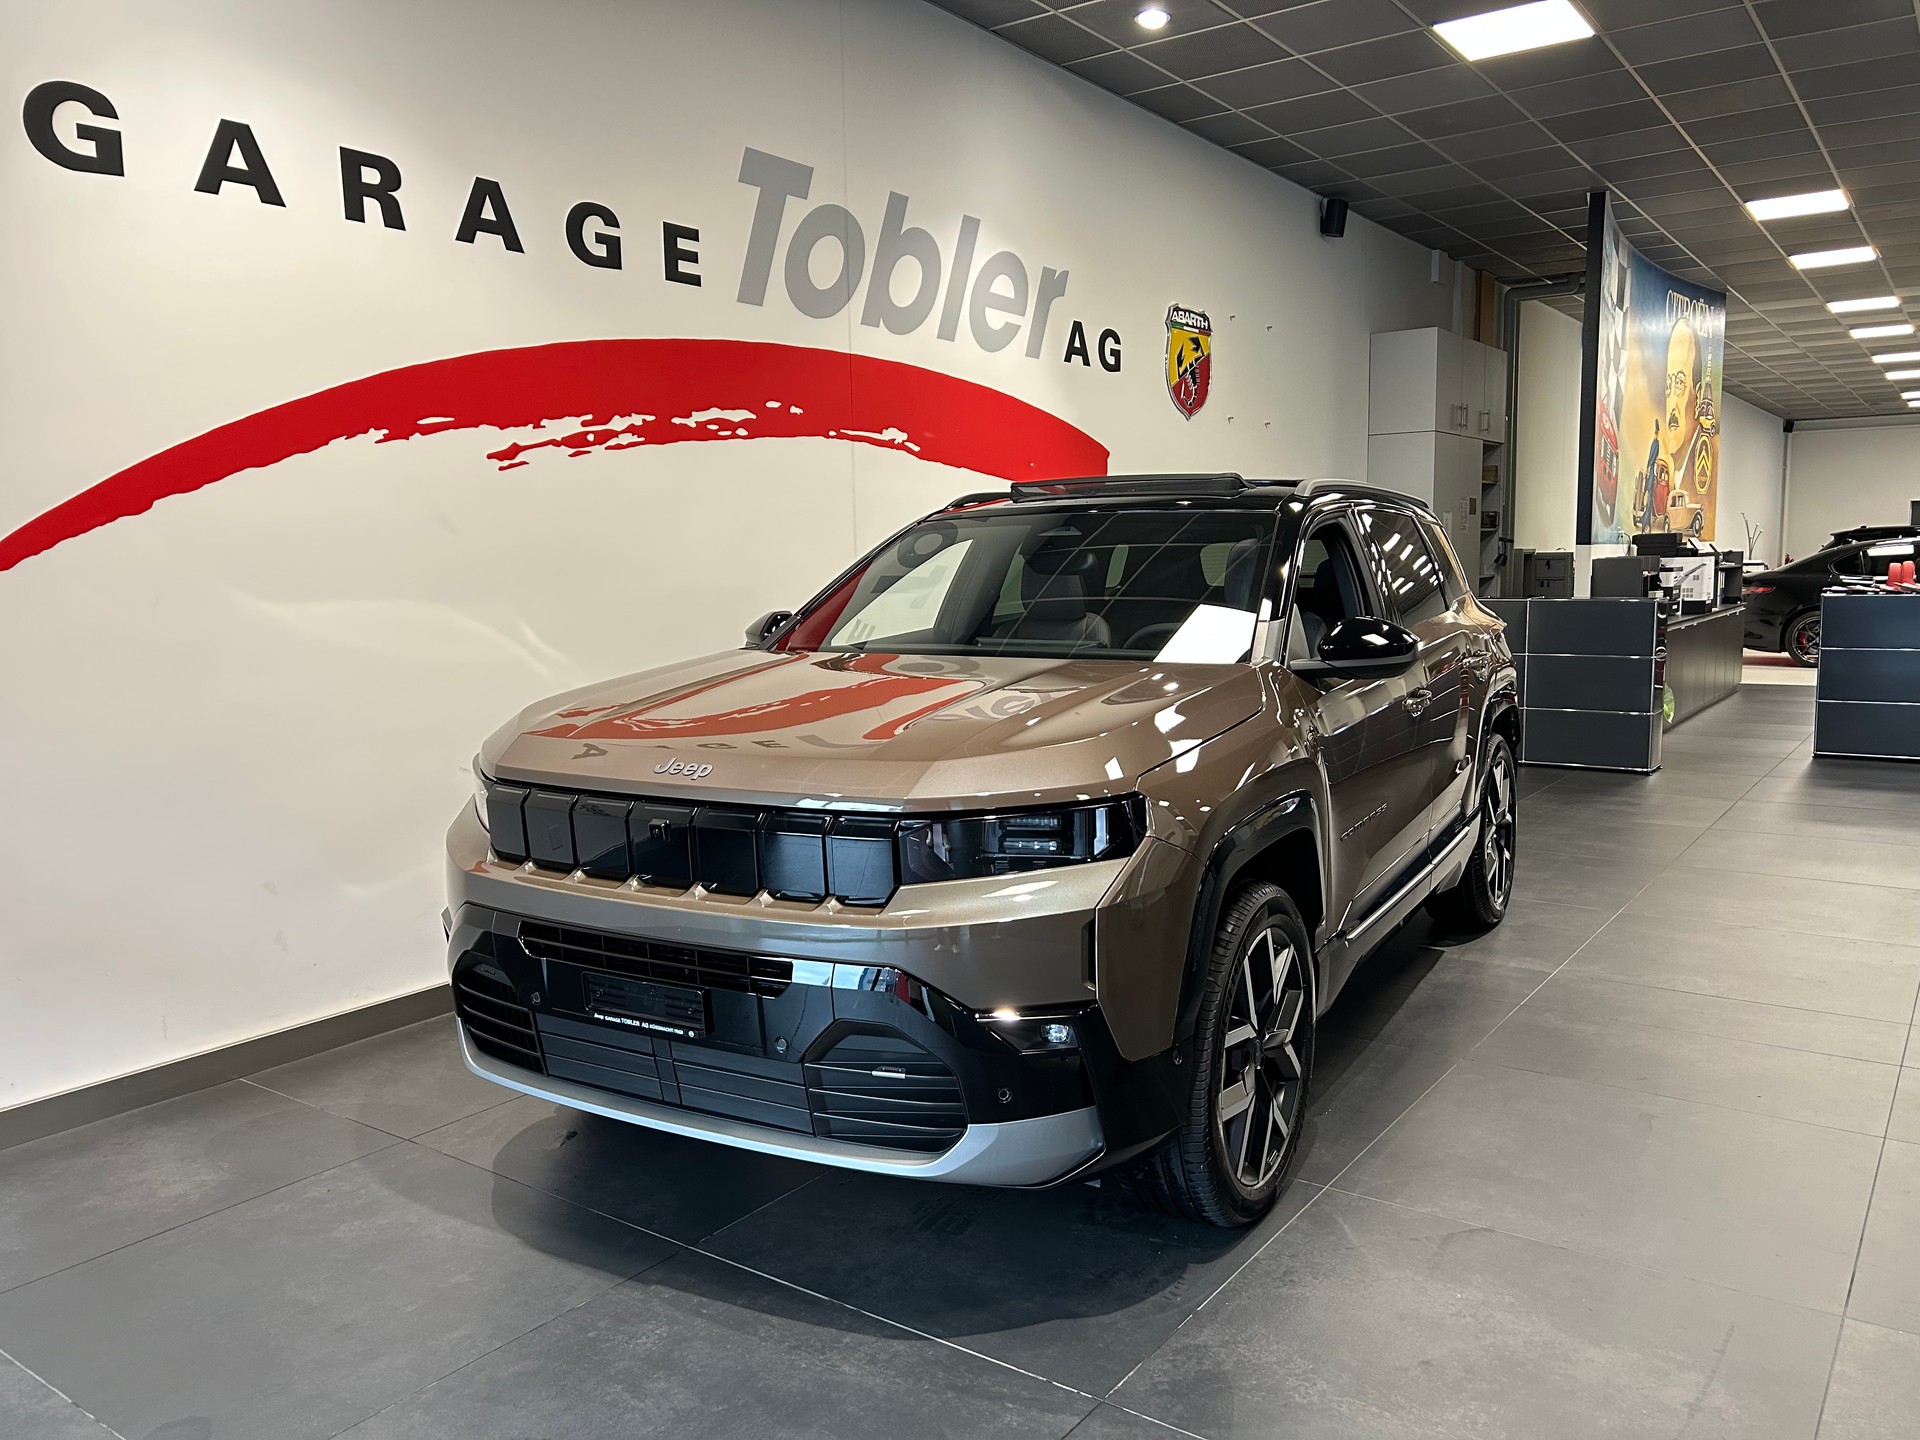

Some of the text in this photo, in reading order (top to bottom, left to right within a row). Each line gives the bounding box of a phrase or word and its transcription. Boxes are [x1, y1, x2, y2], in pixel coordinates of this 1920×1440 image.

[22, 80, 1122, 373] GARAGE Tobler AG
[1171, 310, 1209, 330] ABARTH
[1666, 289, 1715, 339] CITROËN
[653, 757, 714, 780] Jeep
[621, 1017, 640, 1027] TOBLER
[641, 1021, 649, 1029] AG
